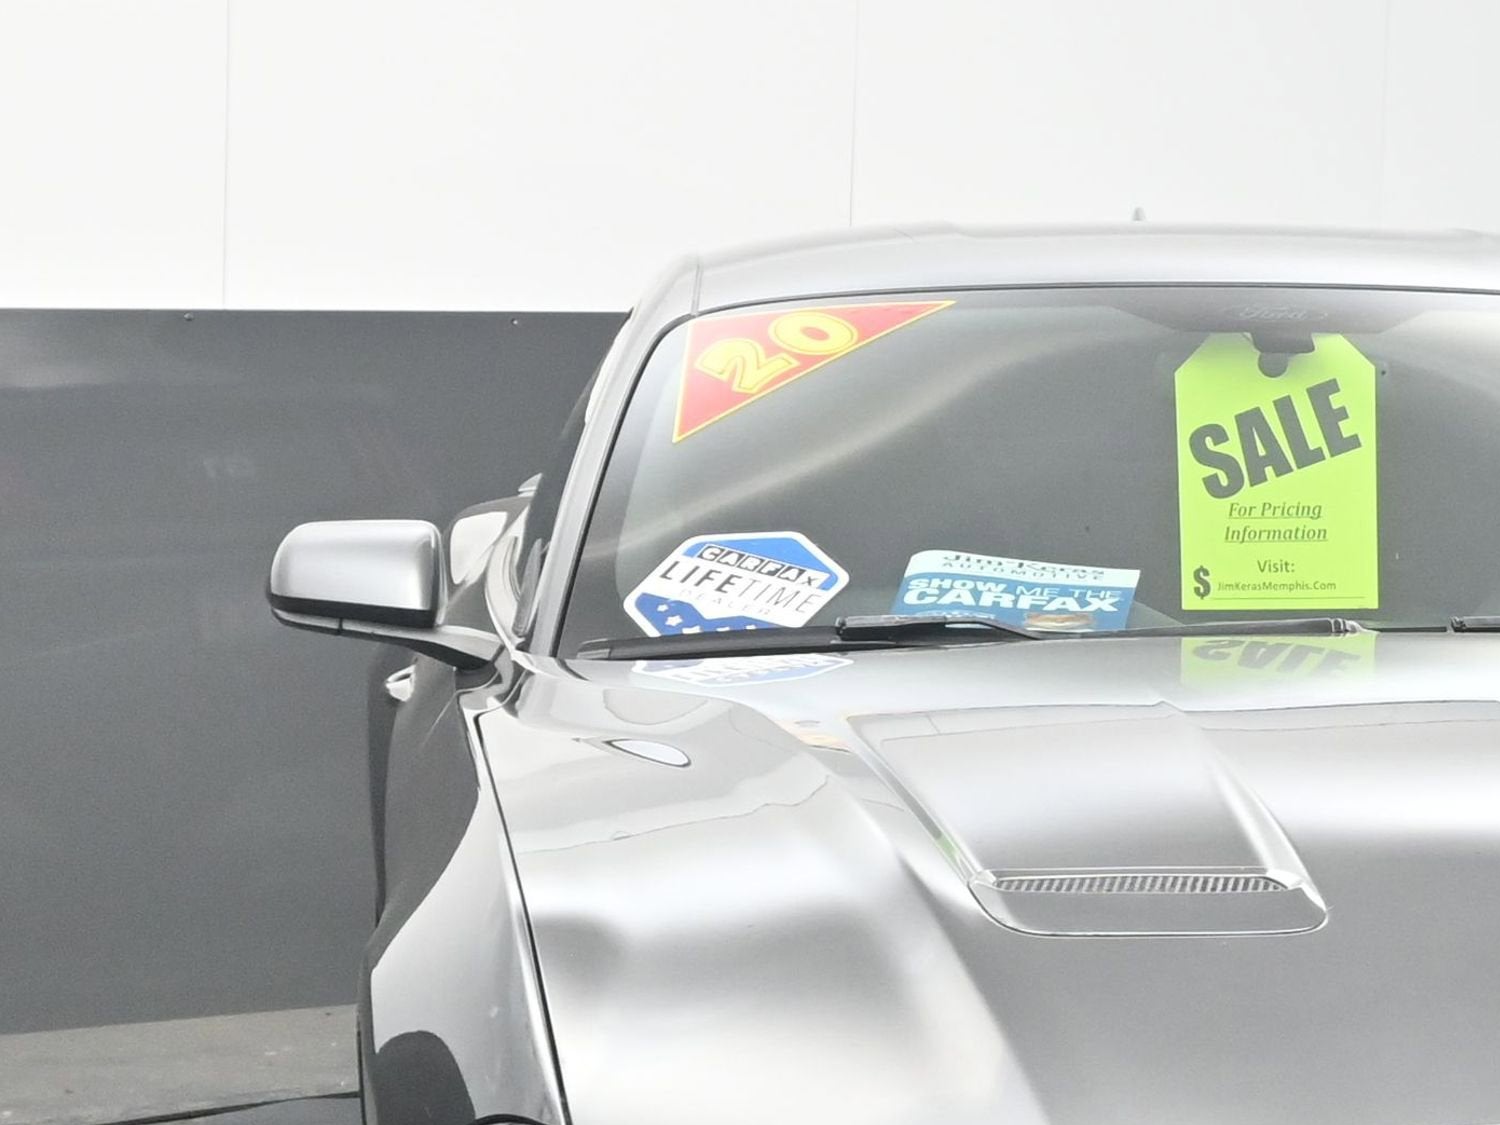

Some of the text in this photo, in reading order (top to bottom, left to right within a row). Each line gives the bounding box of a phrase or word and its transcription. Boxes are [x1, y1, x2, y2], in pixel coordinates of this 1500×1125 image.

[694, 311, 858, 394] 20
[1189, 378, 1362, 499] SALE
[1228, 502, 1322, 519] For Pricing
[1224, 525, 1327, 543] Information
[697, 545, 820, 587] CARFAX
[1256, 560, 1295, 573] Visit:
[660, 561, 824, 614] LIFETIME
[908, 578, 1006, 592] SHOW
[1016, 585, 1058, 598] ME
[1193, 565, 1212, 599] $
[903, 588, 1119, 612] CARFAX
